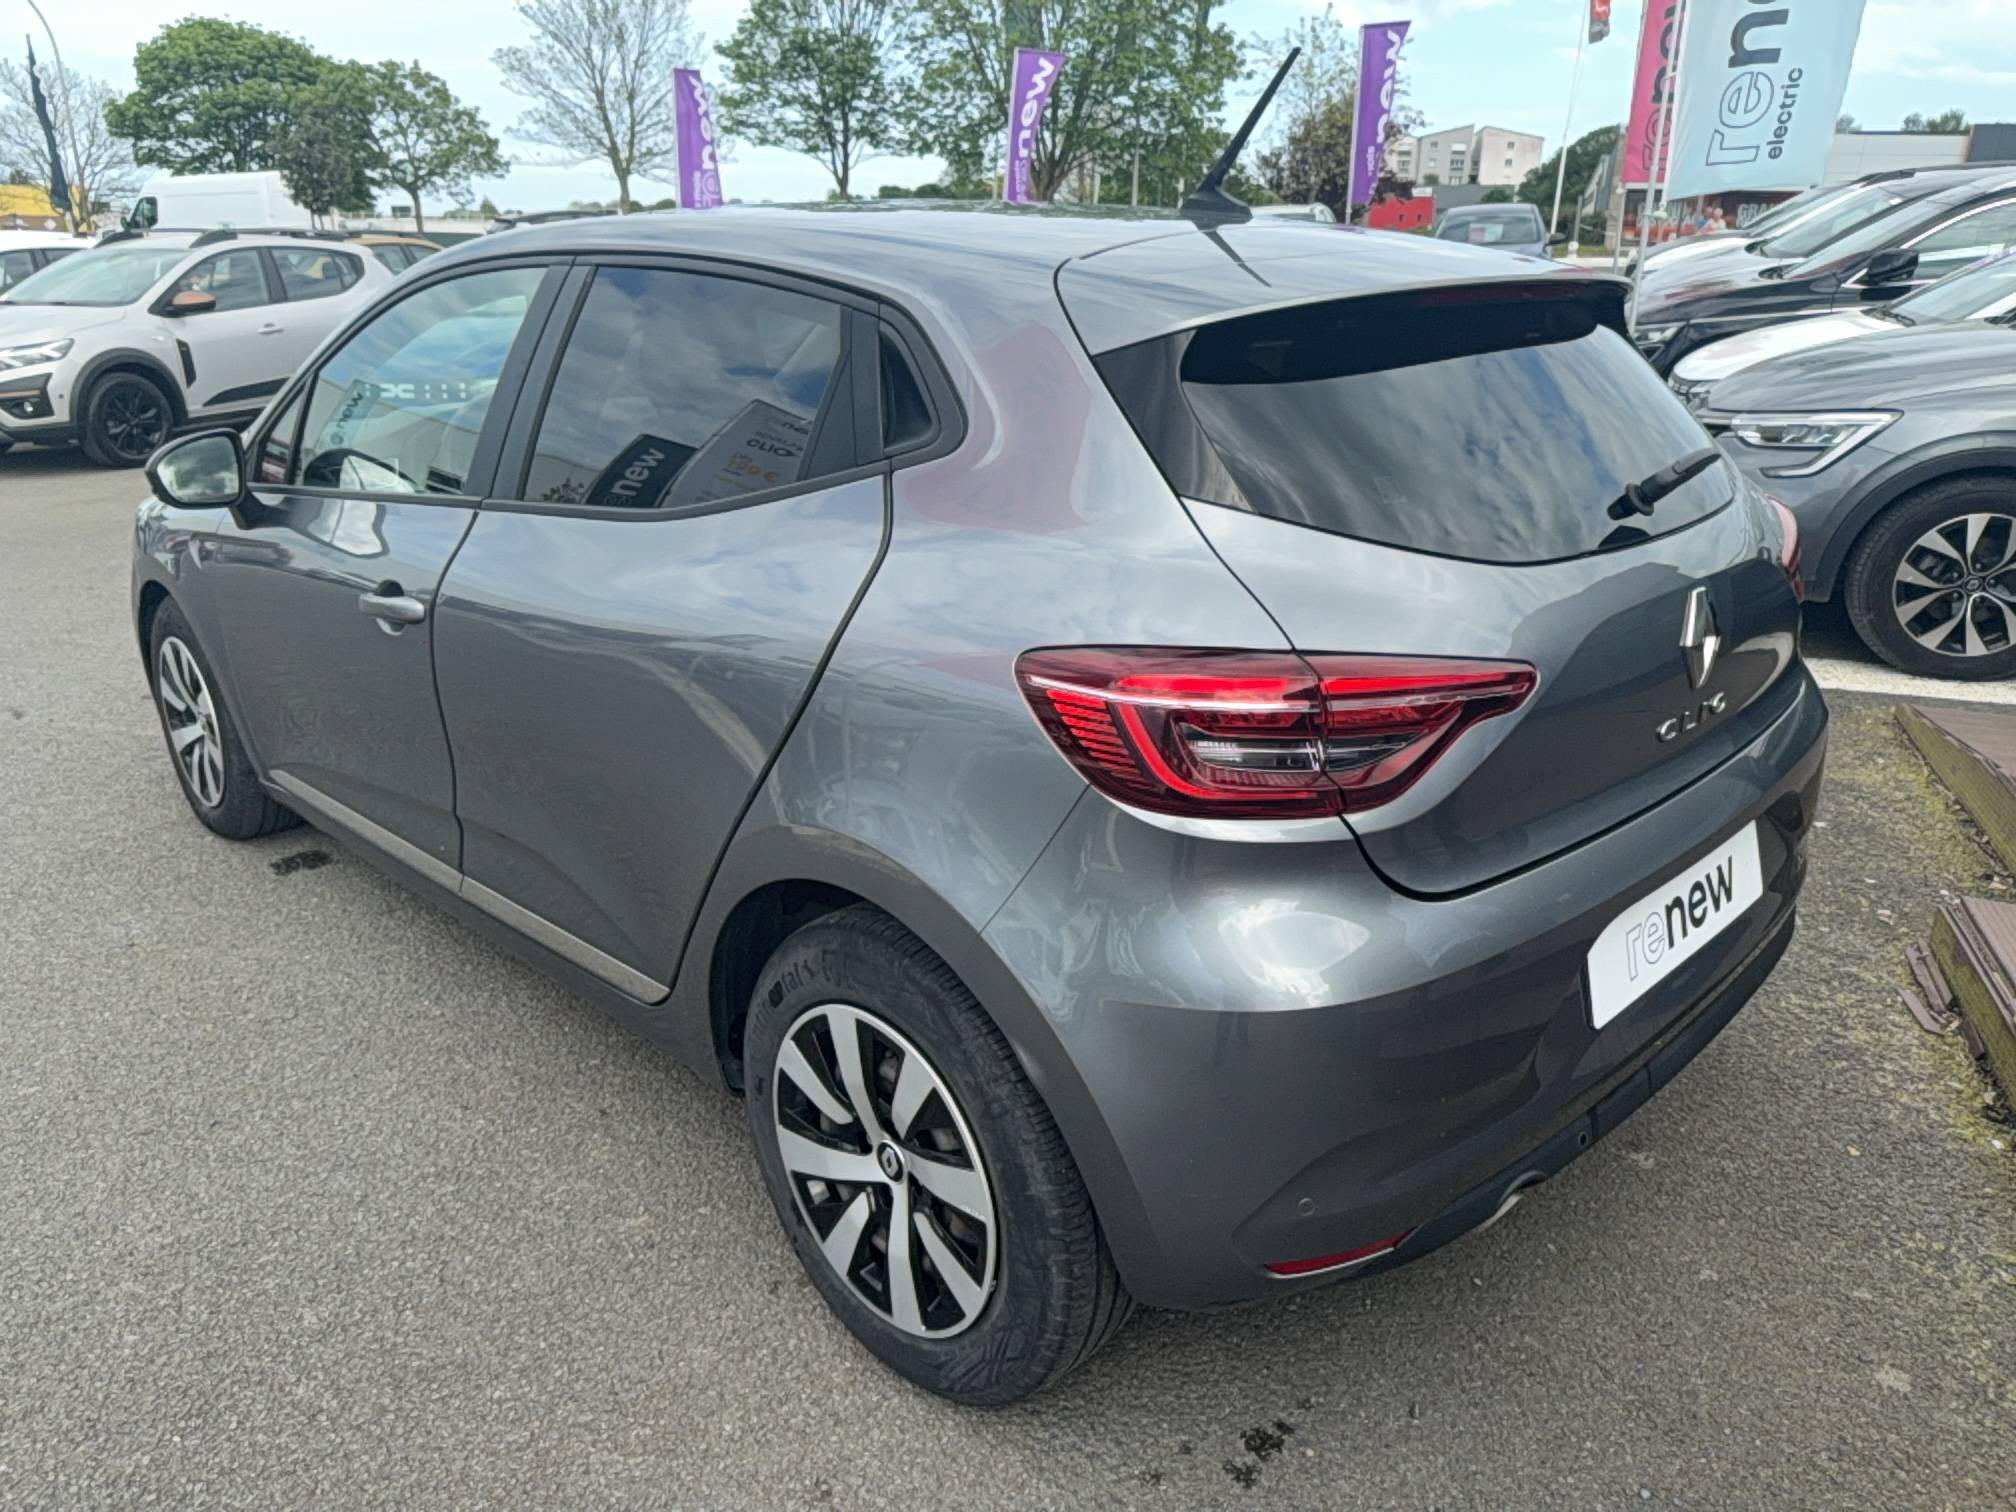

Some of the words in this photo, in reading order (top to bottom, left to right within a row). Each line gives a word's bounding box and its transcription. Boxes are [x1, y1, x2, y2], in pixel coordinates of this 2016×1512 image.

[1766, 67, 1804, 160] electric
[746, 438, 797, 456] CLIO
[1655, 692, 1726, 743] CLIO
[1625, 855, 1733, 982] renew
